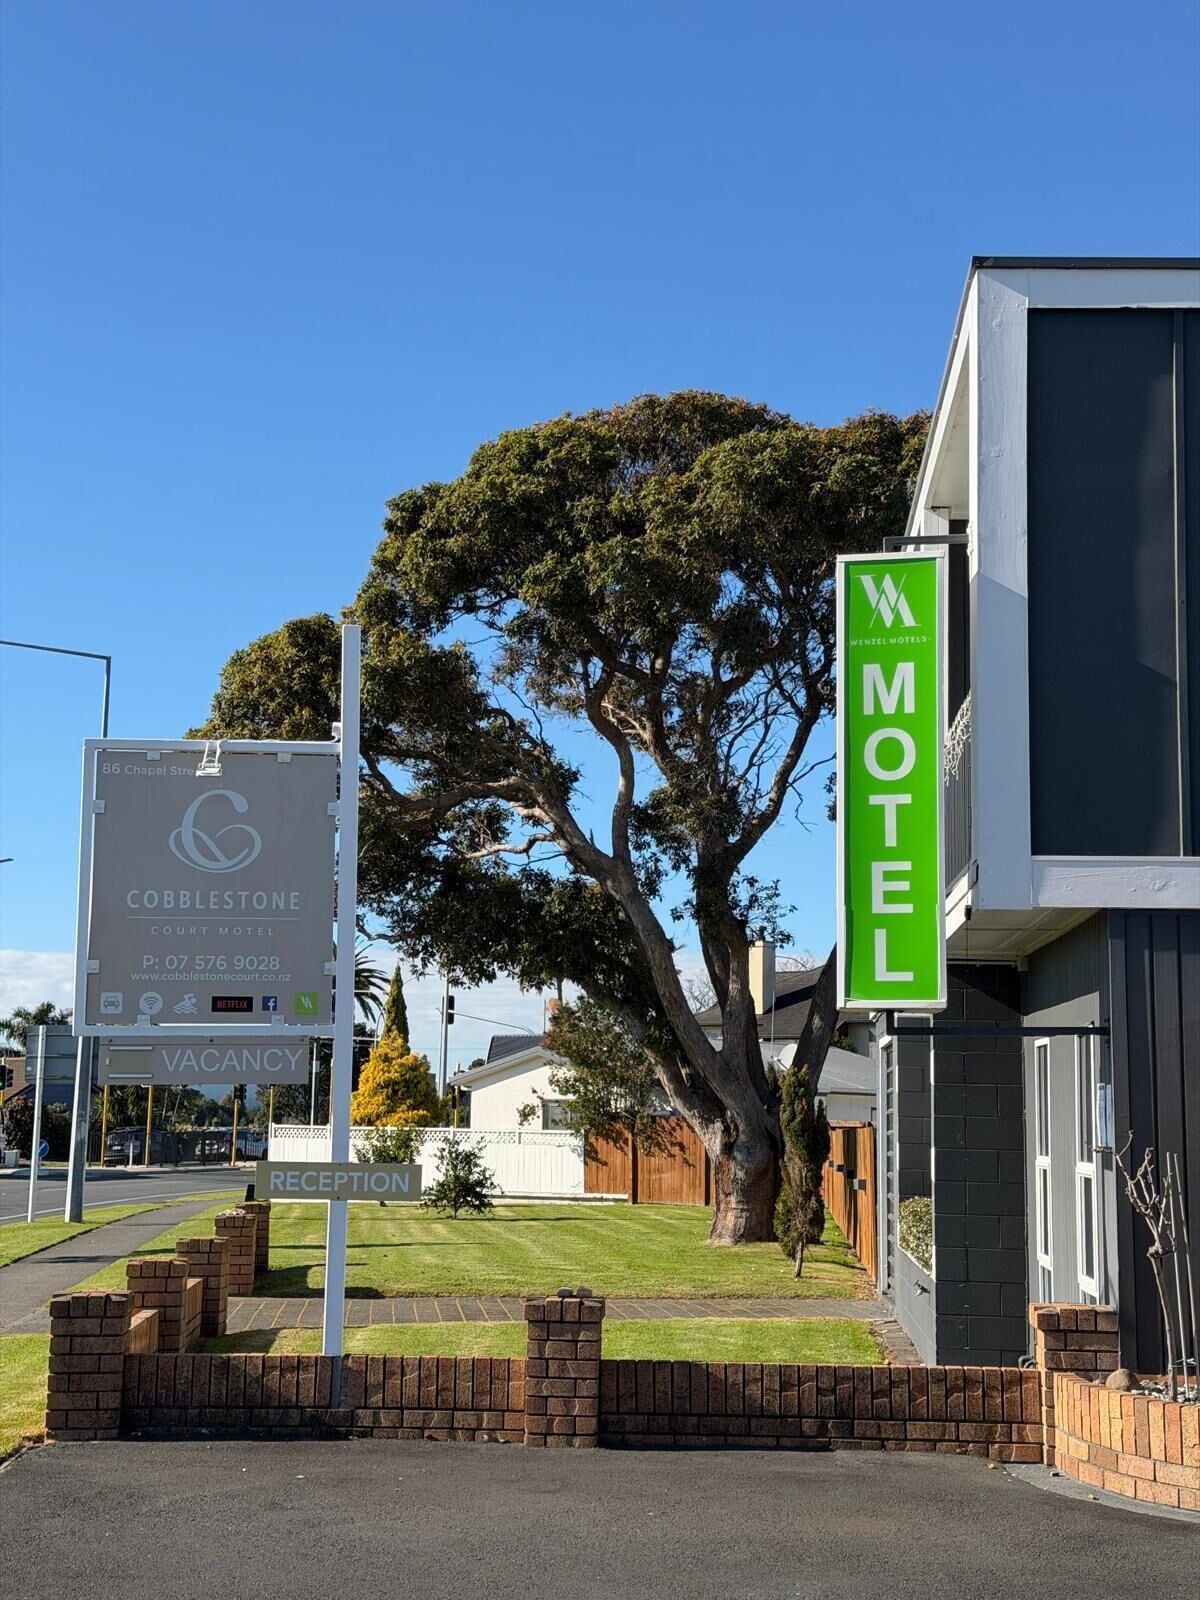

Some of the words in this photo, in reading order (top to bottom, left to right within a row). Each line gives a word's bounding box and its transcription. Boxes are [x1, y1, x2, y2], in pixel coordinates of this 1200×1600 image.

[850, 638, 887, 646] WENZEL
[102, 763, 120, 774] 86
[124, 765, 166, 776] Chapel
[169, 766, 196, 776] Stre
[862, 662, 916, 982] MOTEL
[126, 890, 300, 910] COBBLESTONE
[151, 926, 208, 935] COURT
[219, 927, 275, 936] MOTEL
[143, 955, 159, 970] P:
[165, 955, 189, 970] 07
[194, 955, 227, 970] 576
[233, 955, 280, 970] 9028
[130, 972, 292, 982] www.cobblestonecourt.co.nz
[217, 999, 248, 1009] NETFLIX
[162, 1049, 303, 1072] VACANCY
[270, 1171, 410, 1193] RECEPTION
